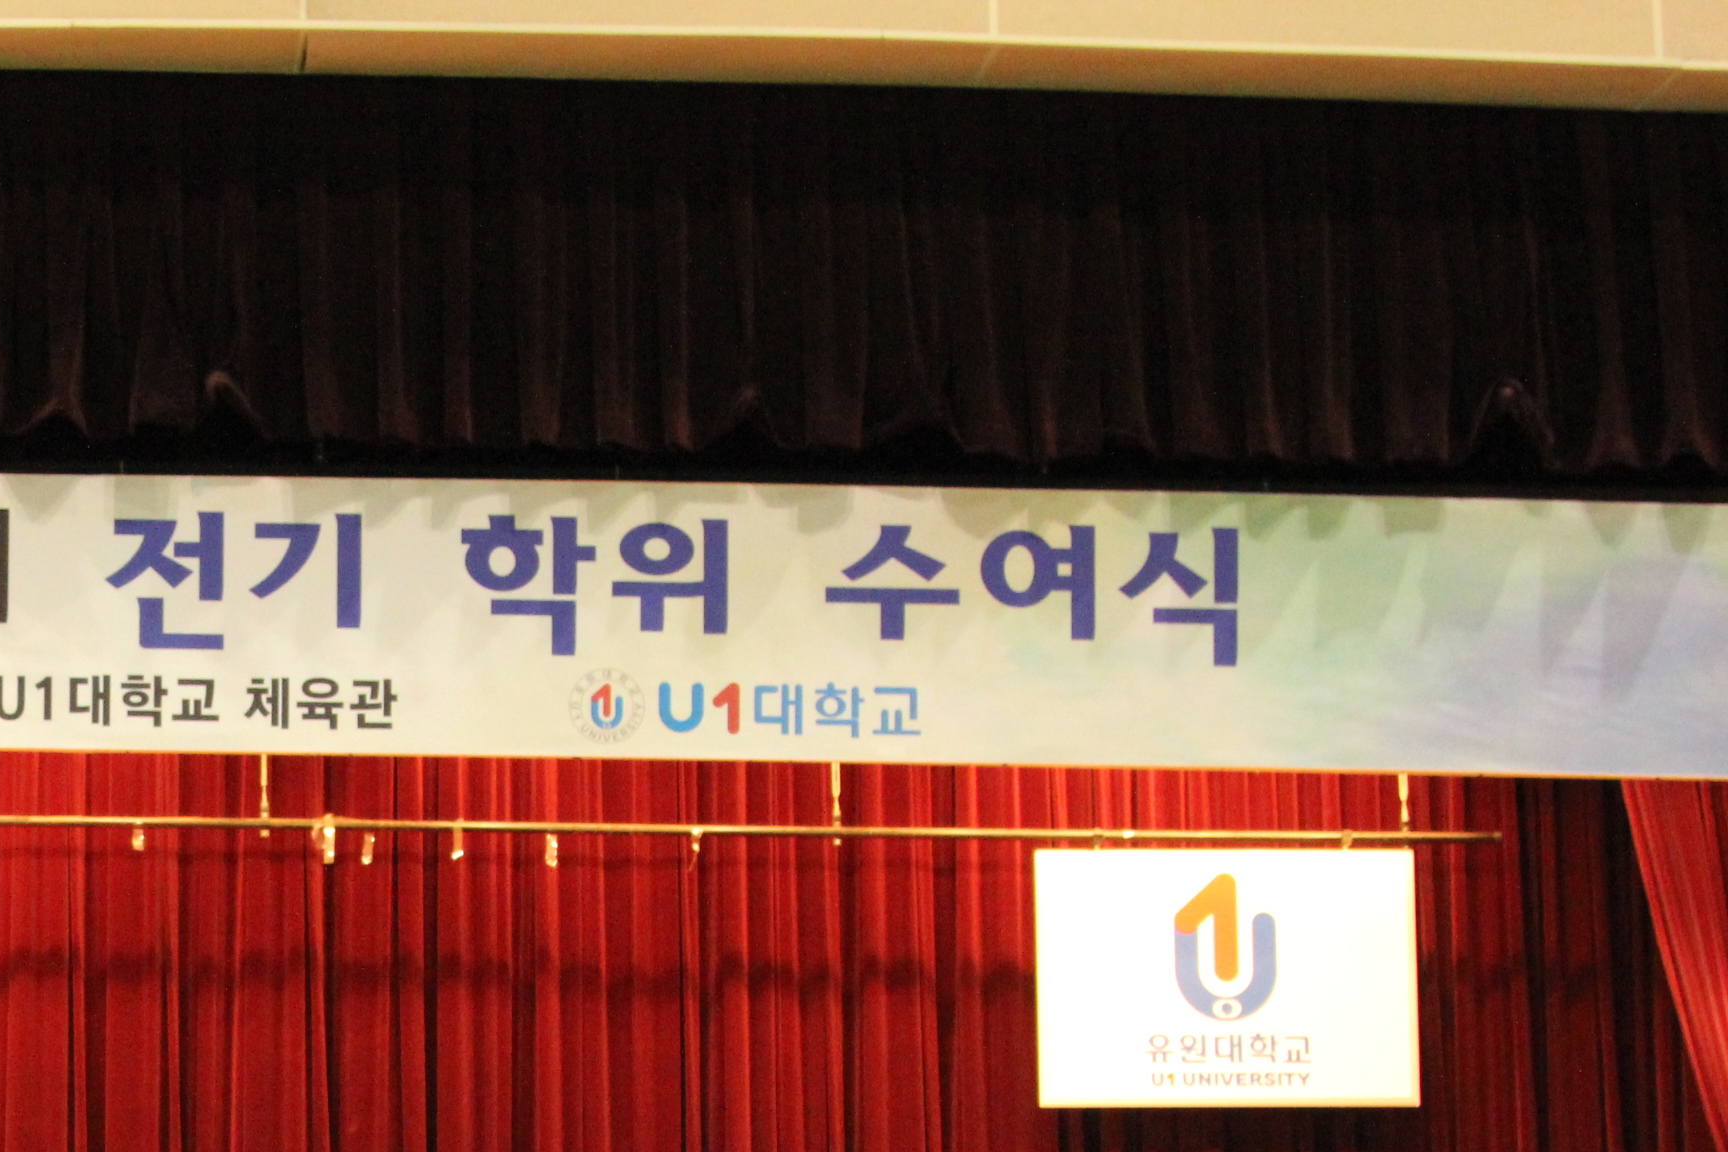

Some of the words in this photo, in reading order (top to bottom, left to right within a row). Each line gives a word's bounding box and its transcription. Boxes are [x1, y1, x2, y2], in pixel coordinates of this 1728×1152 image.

[106, 510, 363, 650] 전기
[461, 514, 730, 656] 학위
[825, 523, 1240, 668] 수여식
[245, 676, 398, 730] 체육관
[658, 681, 922, 739] U1대학교
[1145, 1033, 1313, 1064] 유원대학교
[1150, 1073, 1175, 1087] U1
[1182, 1072, 1311, 1088] UNIVERSITY
